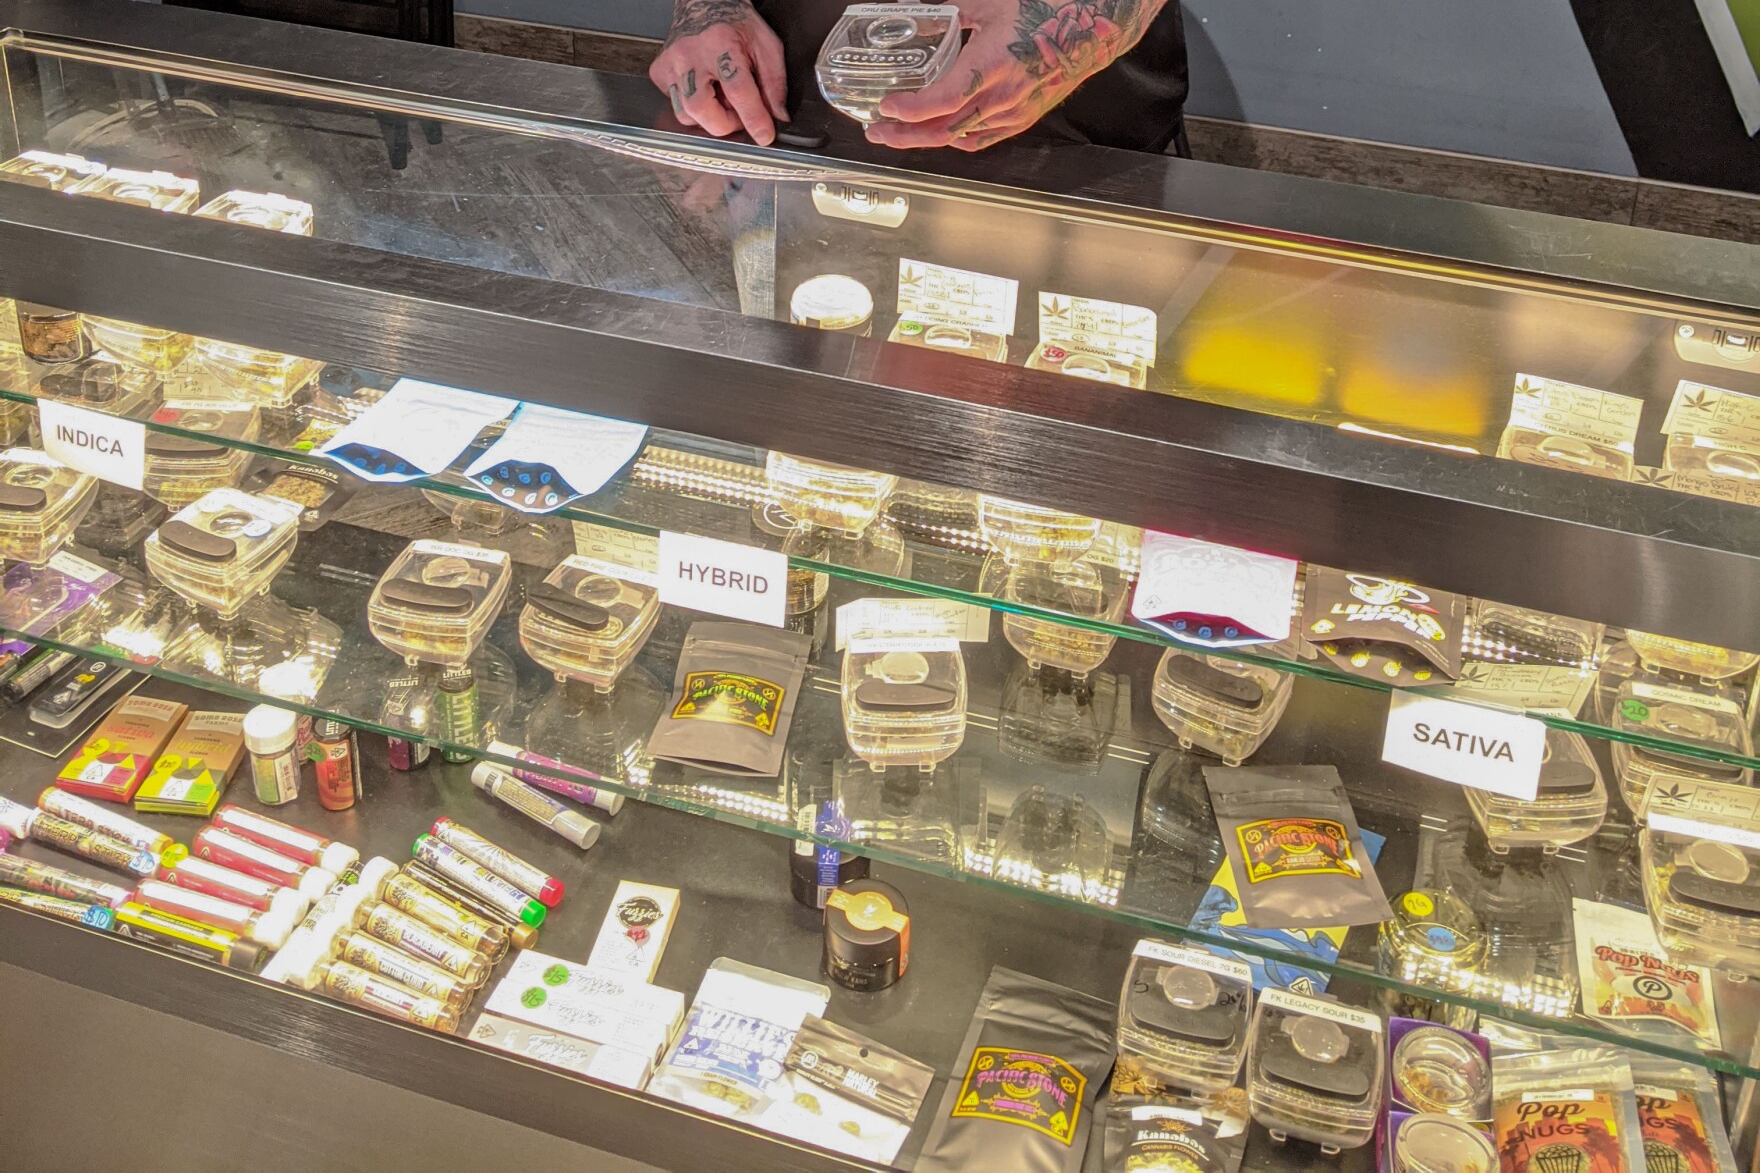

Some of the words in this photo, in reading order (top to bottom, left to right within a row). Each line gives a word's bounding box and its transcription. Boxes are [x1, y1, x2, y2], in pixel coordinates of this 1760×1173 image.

[57, 424, 124, 457] INDICA
[1569, 430, 1601, 443] DREAM
[678, 560, 769, 594] HYBRID
[1330, 603, 1418, 621] LEMON
[1346, 612, 1432, 640] PEPPER
[693, 684, 734, 700] PACIFIC
[735, 687, 769, 711] STONE
[1652, 689, 1686, 701] COSMIC
[1689, 696, 1721, 708] DREAM
[1413, 723, 1514, 763] SATIVA
[93, 843, 132, 866] STICK
[1254, 831, 1300, 859] PACIFIC
[1301, 833, 1339, 856] STONE
[617, 901, 664, 922] Fuzzies
[460, 931, 469, 940] CA
[1161, 950, 1186, 961] SOUR
[1188, 956, 1217, 969] DIESEL
[1219, 964, 1231, 972] 7G
[1233, 967, 1248, 976] $60
[544, 964, 566, 984] $15
[521, 987, 544, 1008] $15
[1270, 993, 1282, 1002] FK
[1284, 995, 1321, 1011] LEGACY
[1322, 1008, 1348, 1020] SOUR
[1350, 1014, 1366, 1024] $35
[717, 1074, 738, 1085] FLOWER
[845, 1068, 880, 1088] MARLEY
[976, 1069, 1028, 1088] PACIFIC
[1026, 1071, 1068, 1109] STONE
[1517, 1101, 1585, 1122] Pop
[1636, 1097, 1672, 1113] op
[1518, 1121, 1591, 1141] NUGS
[1142, 1144, 1173, 1152] CANNABIS
[1173, 1144, 1200, 1161] FLOWER
